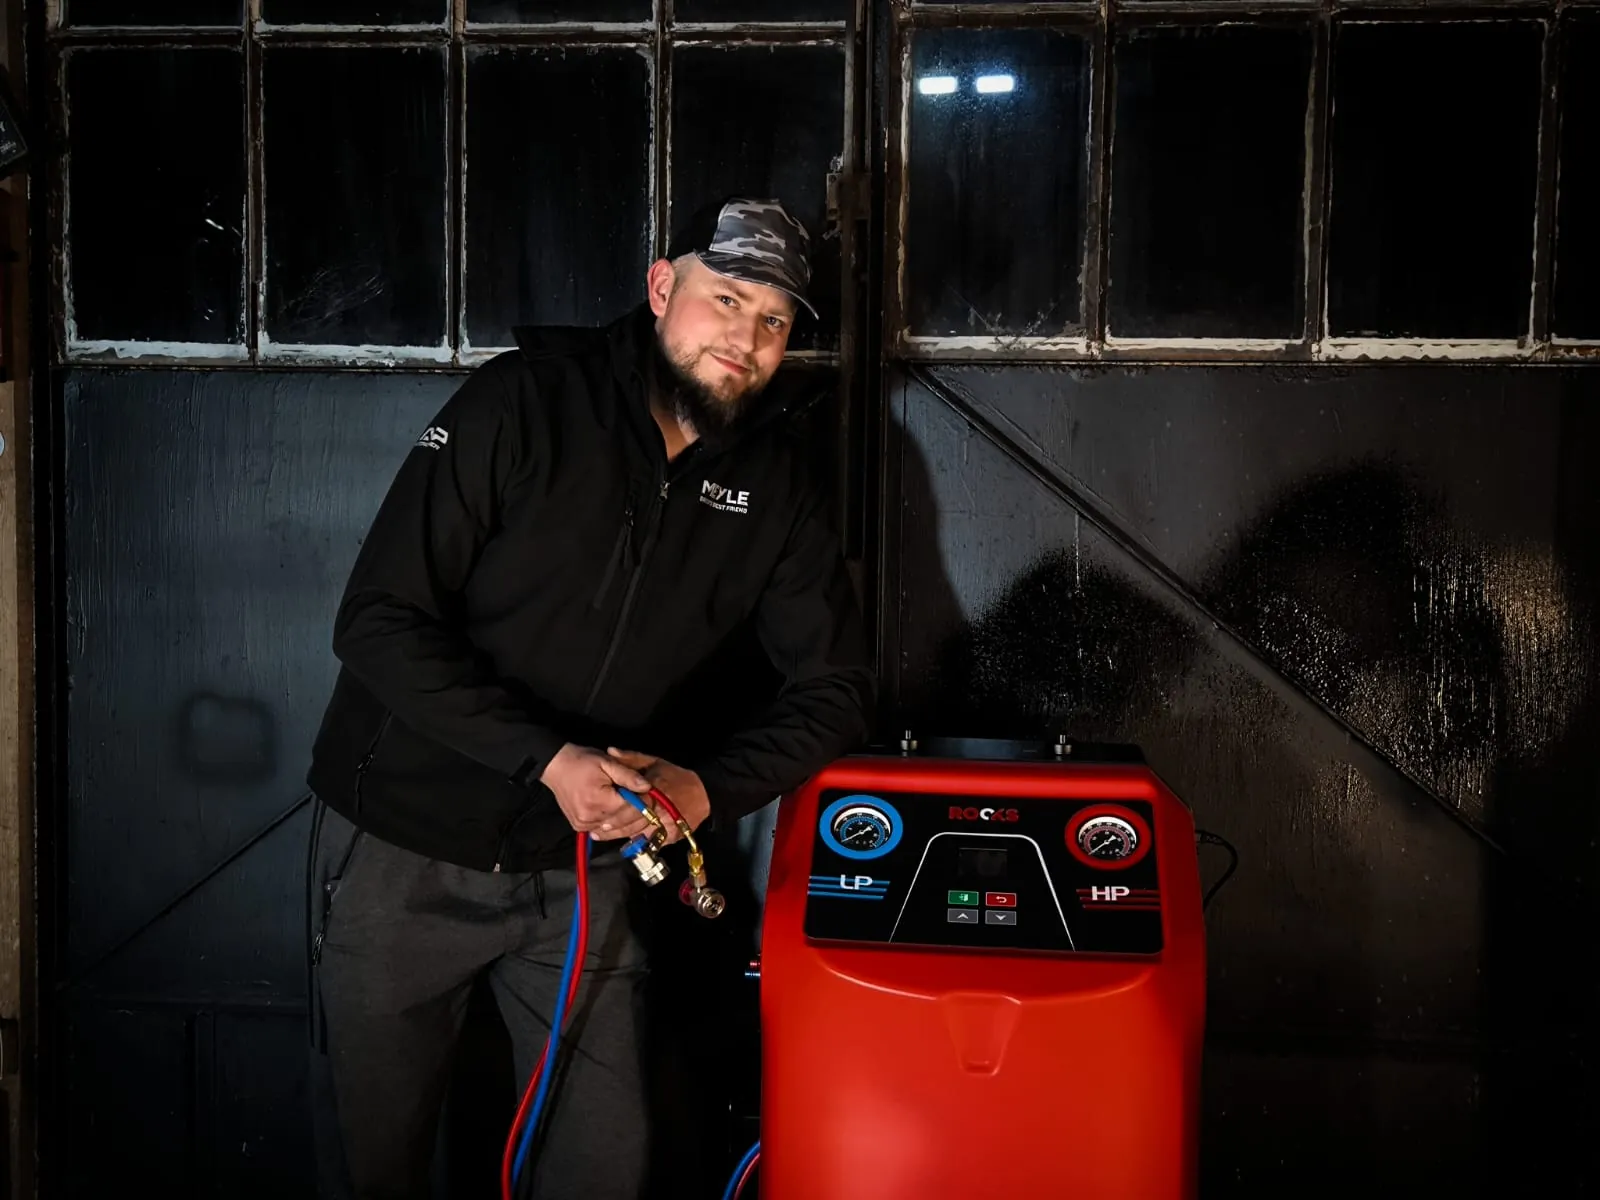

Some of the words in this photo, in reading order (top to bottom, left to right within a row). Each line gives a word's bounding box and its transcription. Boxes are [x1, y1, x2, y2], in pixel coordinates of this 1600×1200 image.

[947, 806, 1020, 822] ROCKS
[839, 874, 873, 890] LP
[1091, 885, 1130, 901] HP
